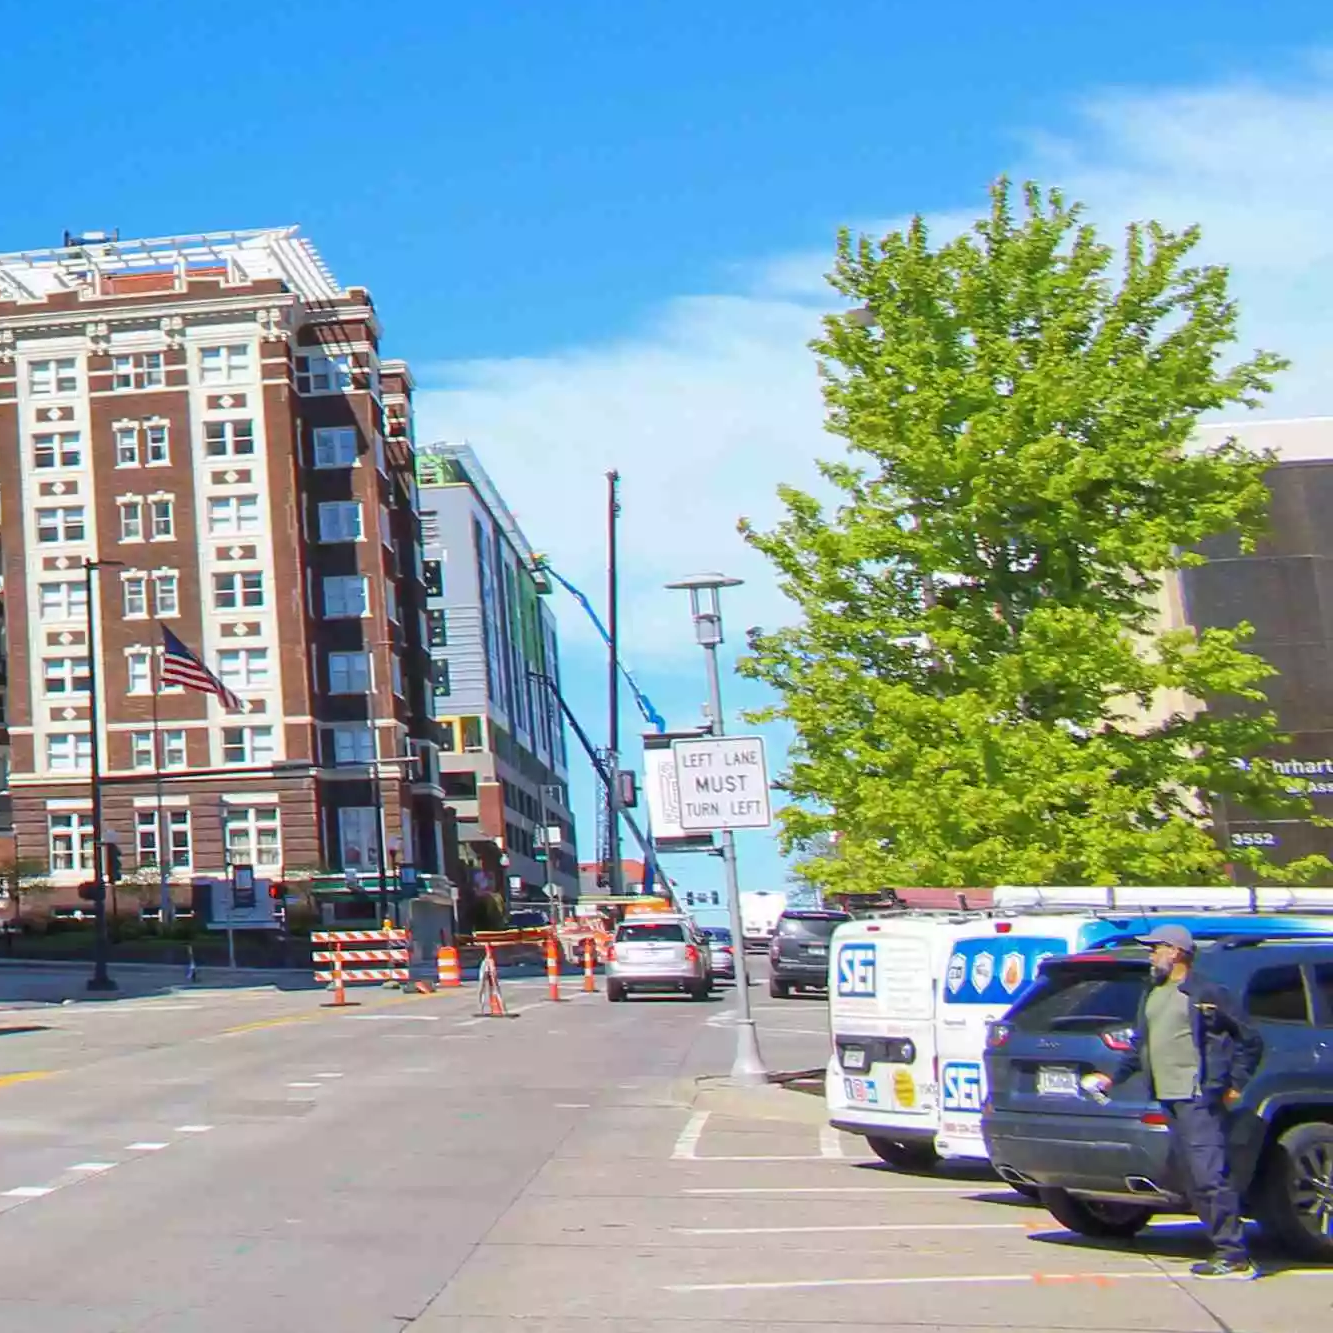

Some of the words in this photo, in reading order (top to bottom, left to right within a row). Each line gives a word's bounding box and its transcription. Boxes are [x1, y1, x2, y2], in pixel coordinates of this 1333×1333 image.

[683, 753, 713, 767] LEFT
[724, 751, 758, 765] LANE
[1271, 759, 1333, 774] hrhart
[696, 775, 747, 792] MUST
[686, 802, 719, 816] TURN
[731, 800, 761, 814] LEFT
[1231, 833, 1275, 845] 3552
